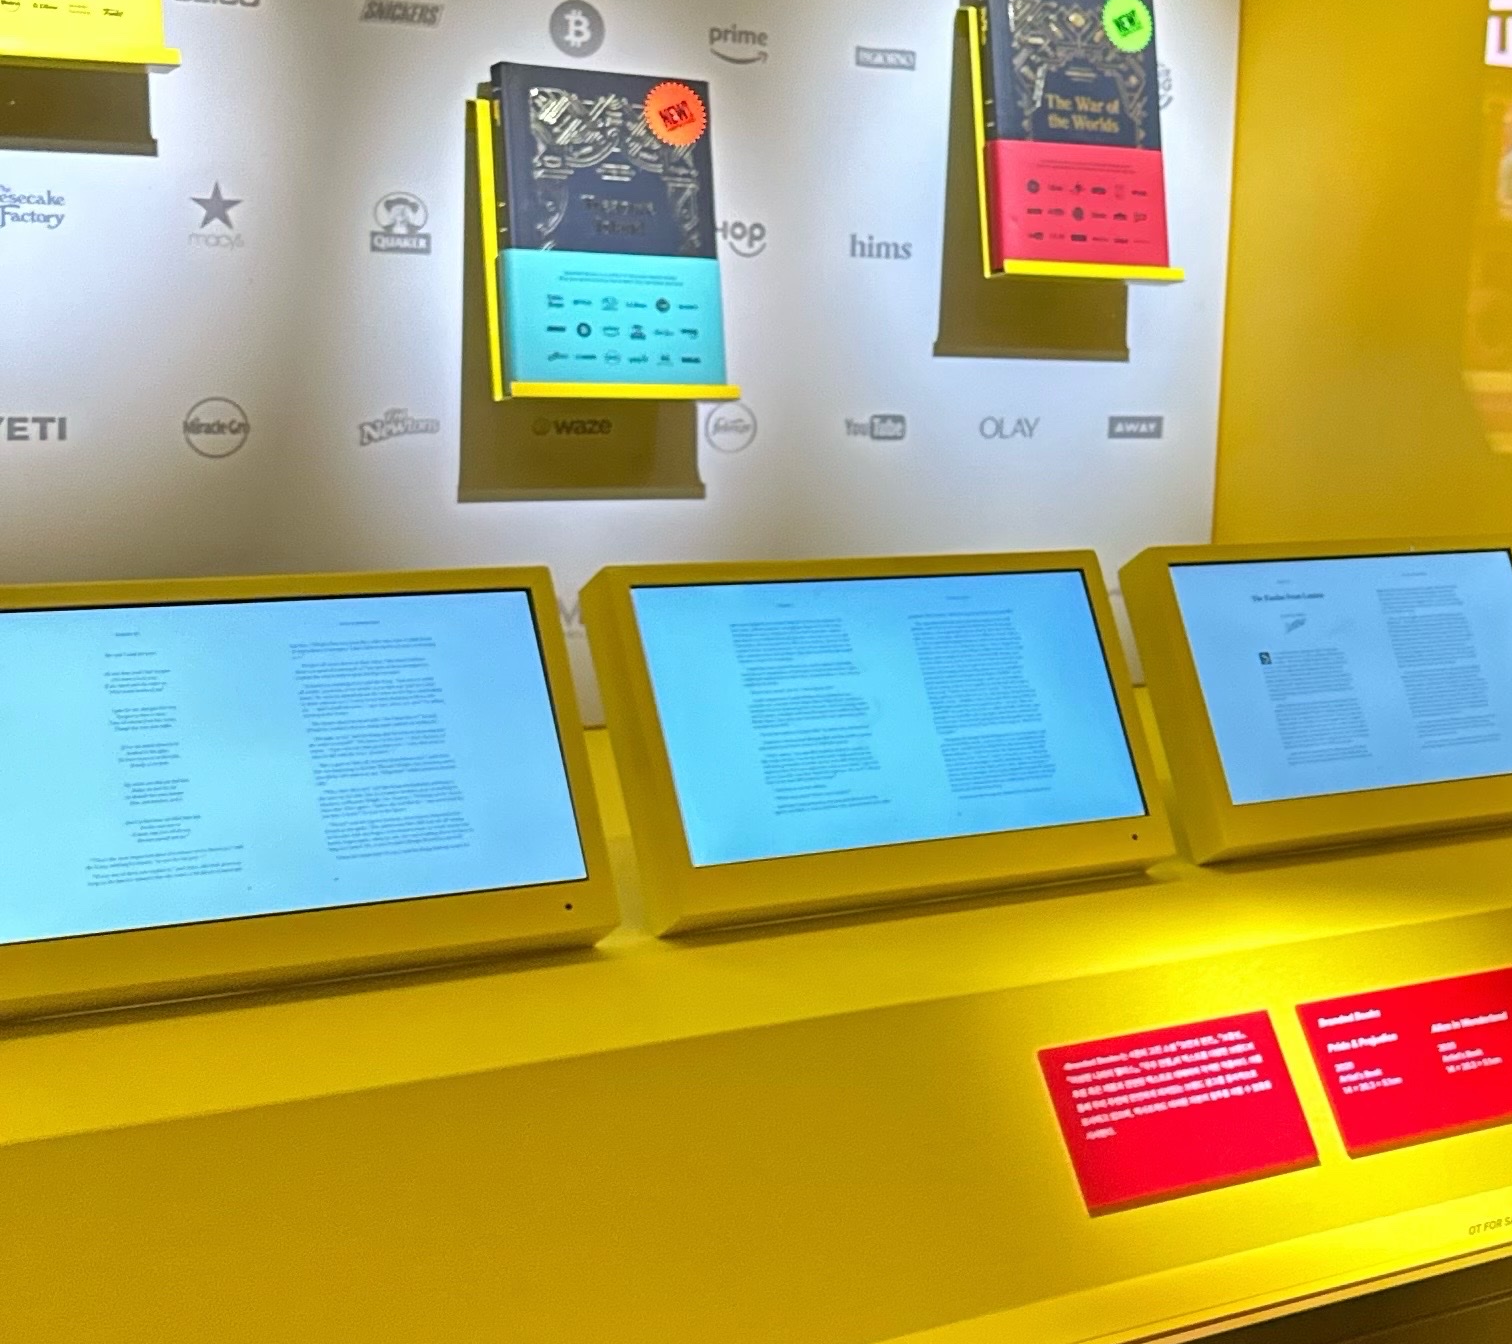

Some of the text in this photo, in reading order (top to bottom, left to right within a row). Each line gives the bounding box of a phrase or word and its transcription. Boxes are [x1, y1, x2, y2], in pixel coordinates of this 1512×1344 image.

[708, 24, 768, 50] prime
[849, 233, 912, 261] hims
[0, 416, 67, 441] ETI
[553, 417, 613, 436] waze
[979, 416, 1041, 440] OLAY
[1114, 421, 1158, 434] AWAY
[1484, 1218, 1503, 1231] FOR
